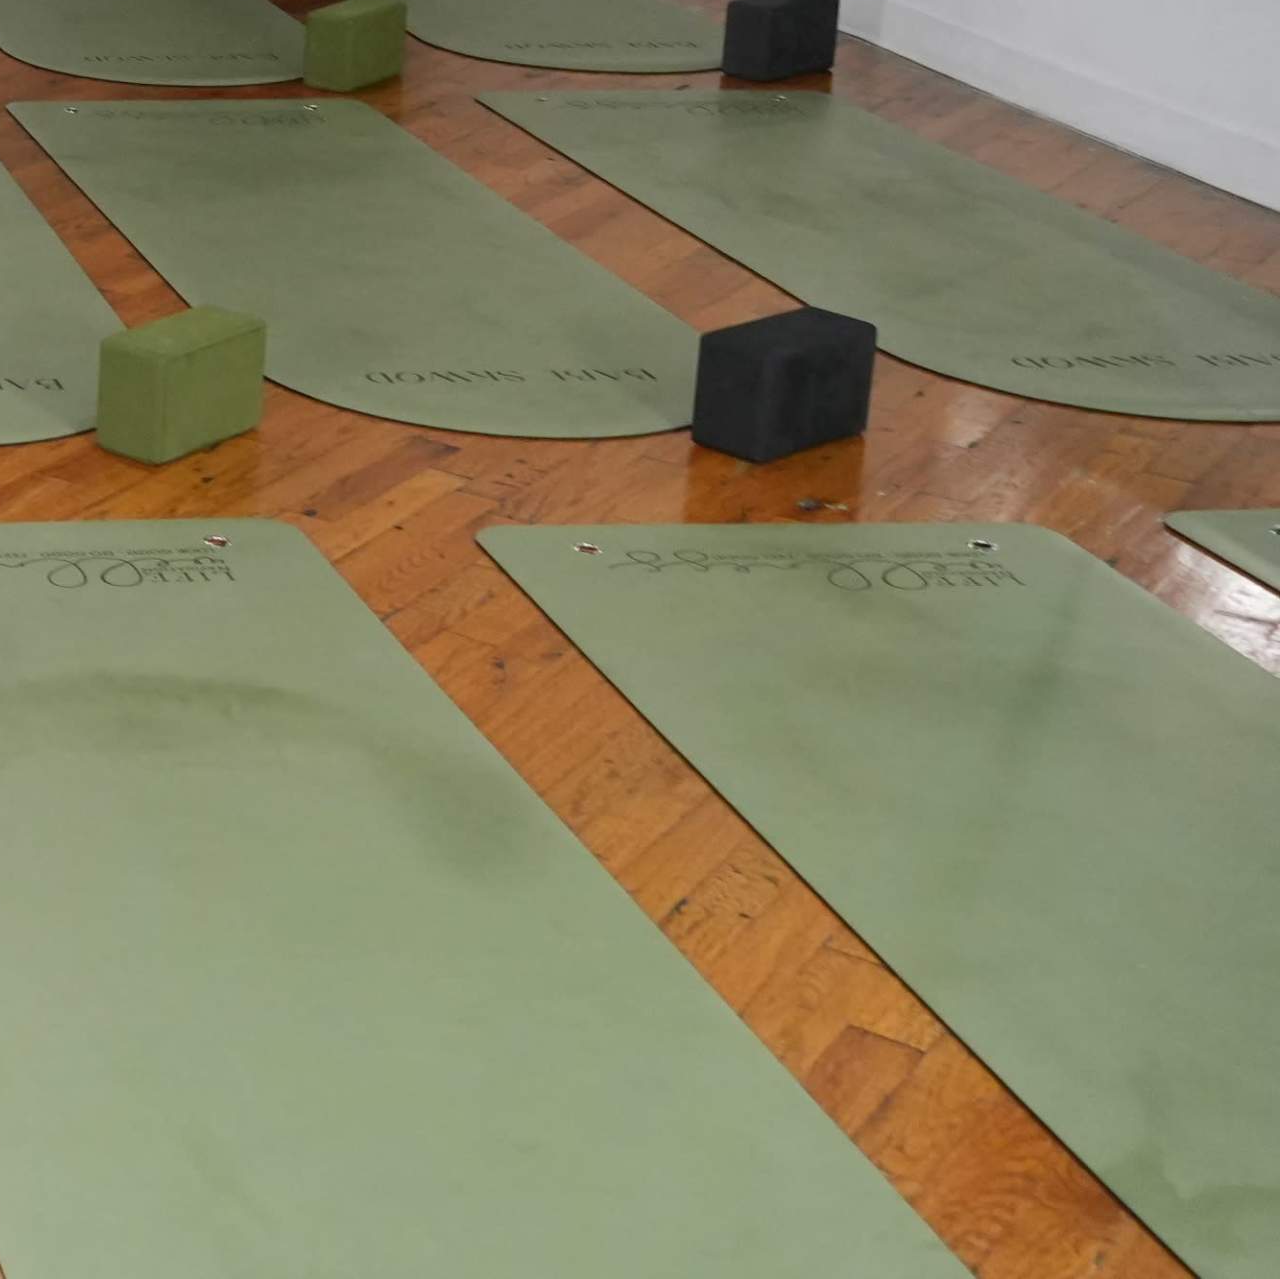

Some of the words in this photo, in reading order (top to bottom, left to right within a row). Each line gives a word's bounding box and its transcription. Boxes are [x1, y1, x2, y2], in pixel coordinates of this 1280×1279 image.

[365, 370, 525, 384] SKWOD
[145, 572, 235, 582] LIFE
[933, 572, 1025, 586] LIFE
